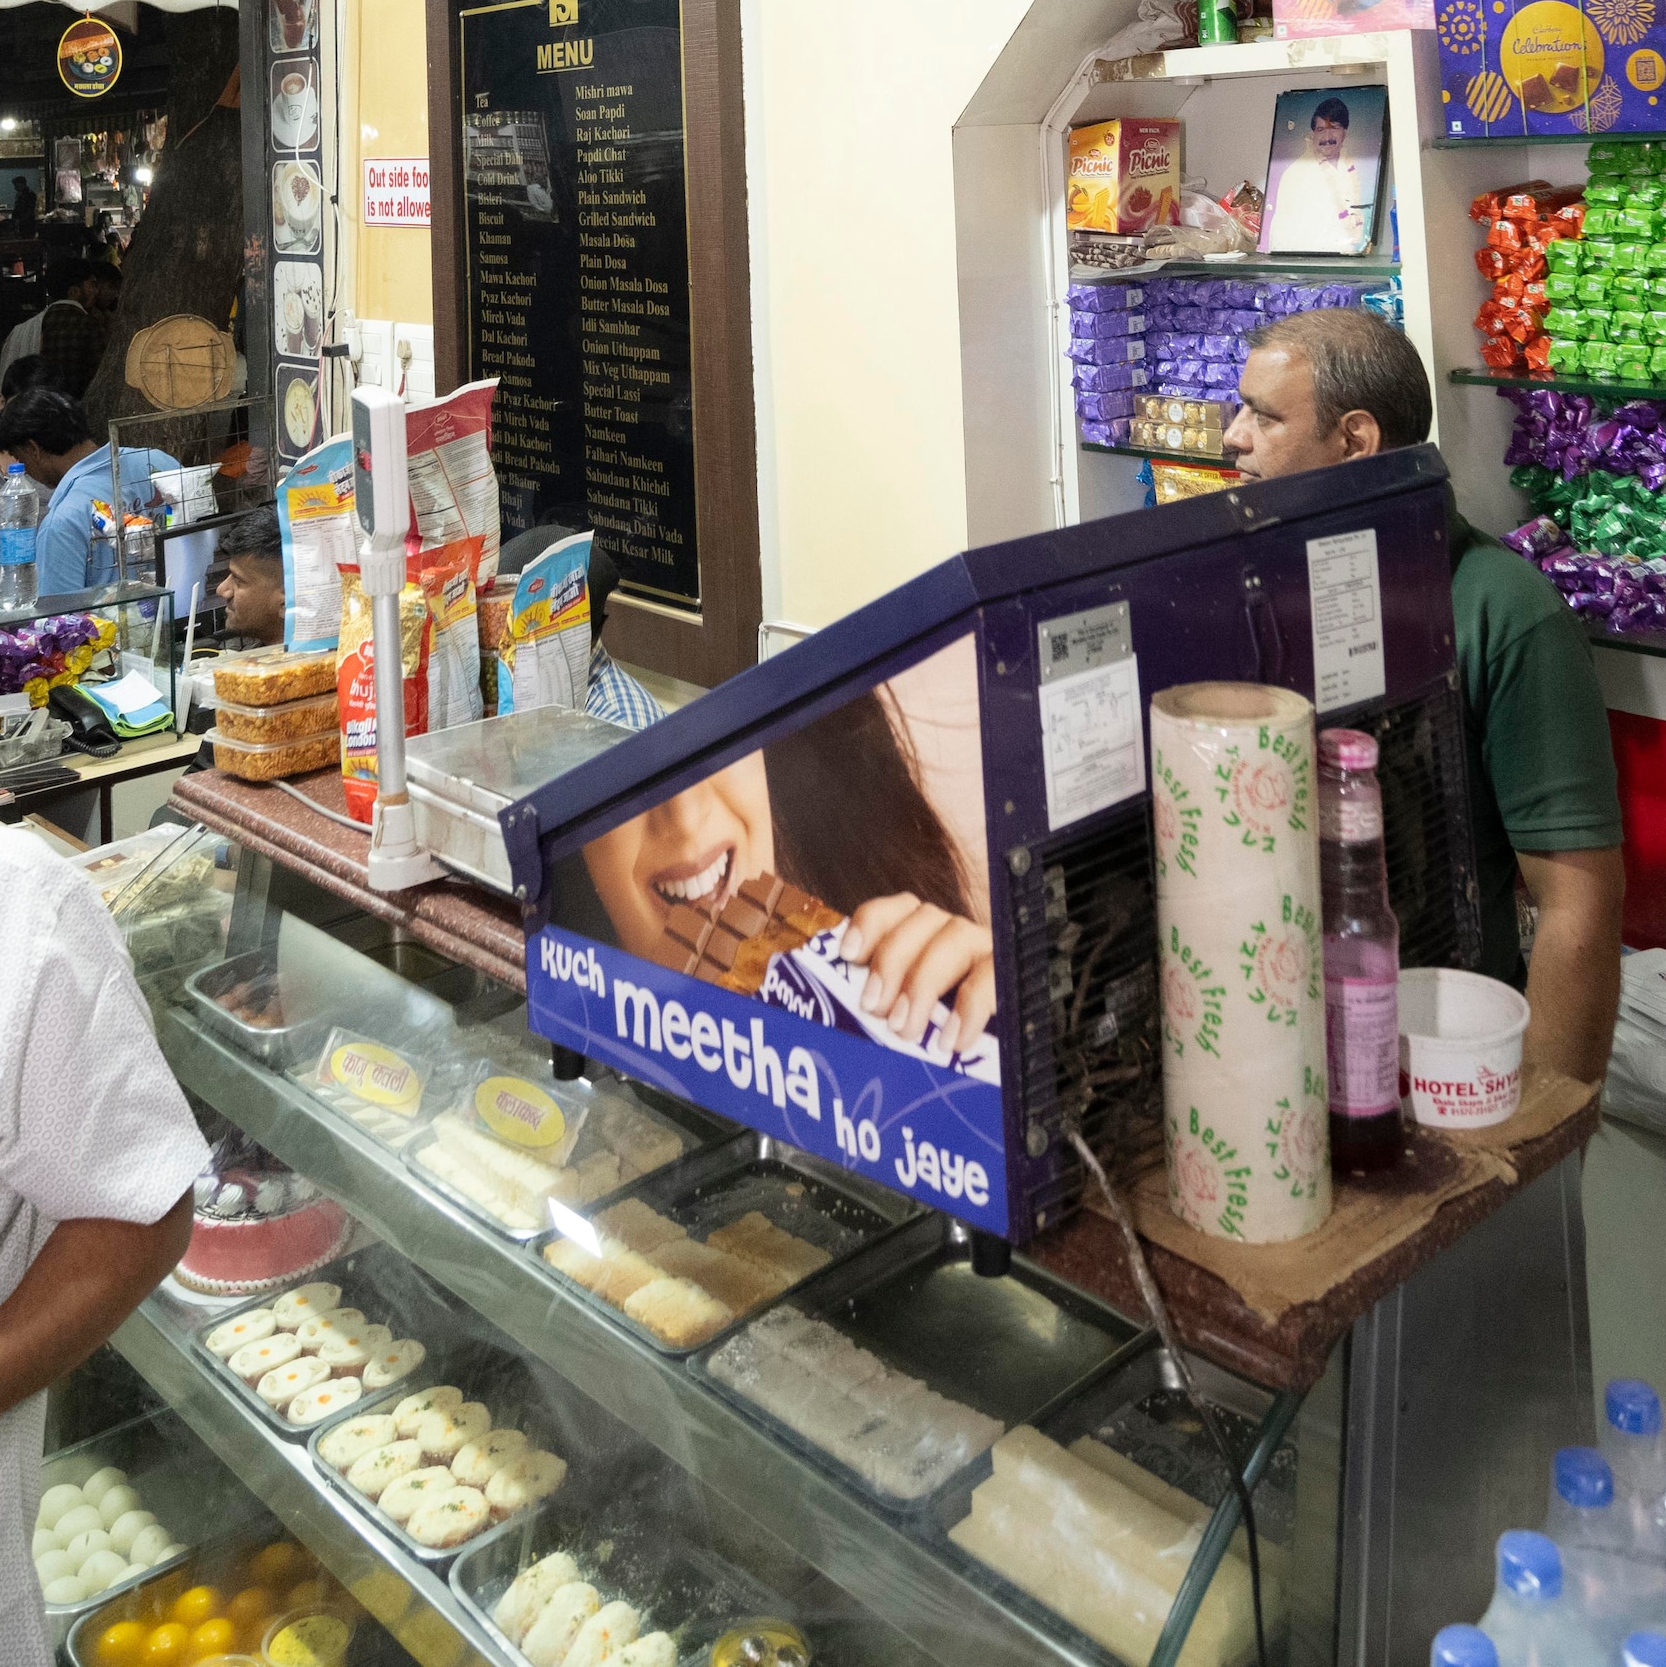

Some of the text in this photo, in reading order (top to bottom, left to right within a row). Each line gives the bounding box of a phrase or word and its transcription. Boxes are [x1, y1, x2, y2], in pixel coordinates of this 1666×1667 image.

[537, 39, 593, 70] MENU
[1513, 36, 1587, 55] Celebrations
[575, 86, 604, 100] Mishri
[575, 104, 625, 121] Soan Papdi
[576, 126, 630, 145] Raj Kachori
[577, 148, 626, 165] Papdi Chat
[1071, 156, 1113, 176] Picnic
[1129, 146, 1171, 175] Picnic
[369, 166, 428, 188] Out side foo
[578, 170, 624, 184] Aloo Tikki
[367, 196, 431, 217] is not allowe
[578, 191, 646, 205] Plain Sandwich
[479, 212, 504, 225] Biscuit
[579, 212, 656, 227] Grilled Sandwich
[479, 232, 511, 246] Khaman
[580, 233, 635, 249] Masala Dosa
[480, 252, 508, 265] Samosa
[580, 254, 626, 270] Plain Dosa
[480, 271, 537, 286] Mawa Kachori
[581, 275, 668, 294] Onion Masala Dosa
[481, 290, 531, 306] Pyaz Kachori
[581, 296, 670, 316] Butter Masala Dosa
[482, 310, 526, 326] Mirch Vada
[599, 320, 640, 337] Sambhar
[482, 330, 528, 347] Dal Kachori
[482, 349, 535, 368] Bread Pakoda
[582, 339, 660, 363] Onion Uthappam
[502, 372, 532, 387] Samosa
[583, 361, 670, 385] Mix Veg Uthappam
[503, 391, 522, 410] Pyaz
[583, 381, 640, 402] Special Lassi
[584, 402, 638, 424] Butter Toast
[531, 416, 549, 432] Vada
[504, 432, 552, 453] Dal Kachori
[585, 424, 626, 445] Namkeen
[505, 452, 560, 475] Bread Pakoda
[586, 445, 663, 473] Falhari Namkeen
[508, 473, 541, 492] Bhature
[586, 467, 669, 497] Sabudana Khichdi
[501, 490, 522, 509] Bhaji
[587, 488, 658, 517] Sabudana Tikki
[507, 512, 526, 528] Vada
[588, 510, 683, 545] Sabudana Dahi Vada
[622, 538, 674, 566] Kesar Milk
[342, 1050, 410, 1094] काजू कतली
[613, 978, 821, 1121] meetha
[832, 1098, 882, 1162] ho
[895, 1126, 990, 1207] jaye
[1414, 1077, 1478, 1096] HOTEL
